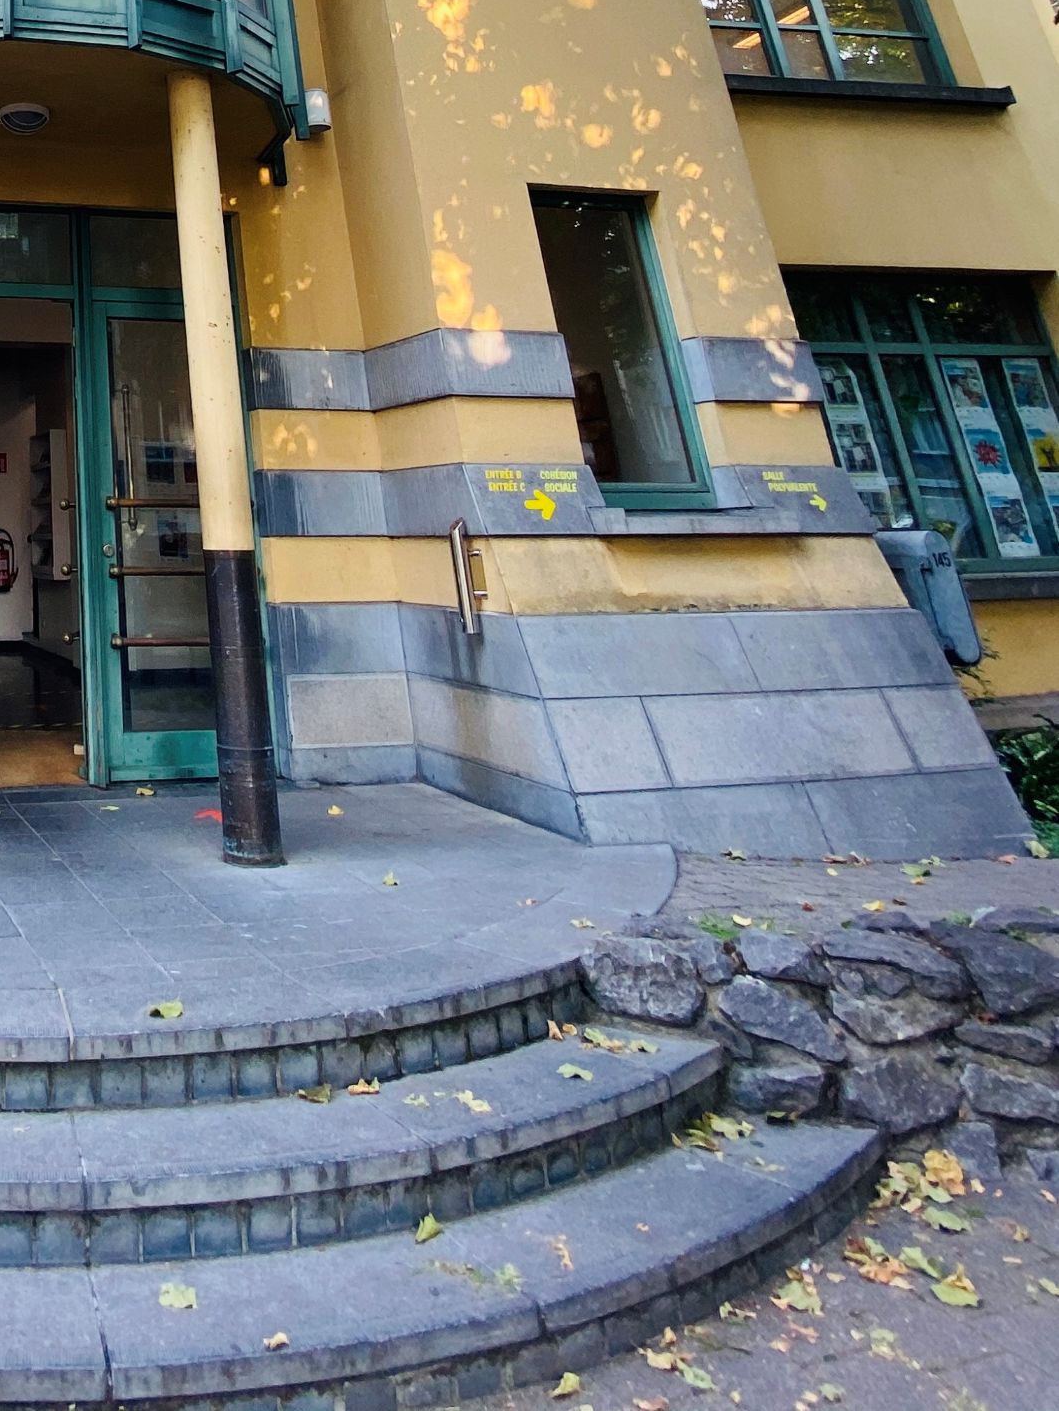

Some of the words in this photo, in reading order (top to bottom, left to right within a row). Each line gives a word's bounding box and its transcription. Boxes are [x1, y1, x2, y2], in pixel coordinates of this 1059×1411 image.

[485, 468, 514, 480] ENTRÉE
[488, 480, 518, 492] ENTRÉE
[544, 482, 578, 493] SOCIALE
[932, 552, 952, 568] 145
